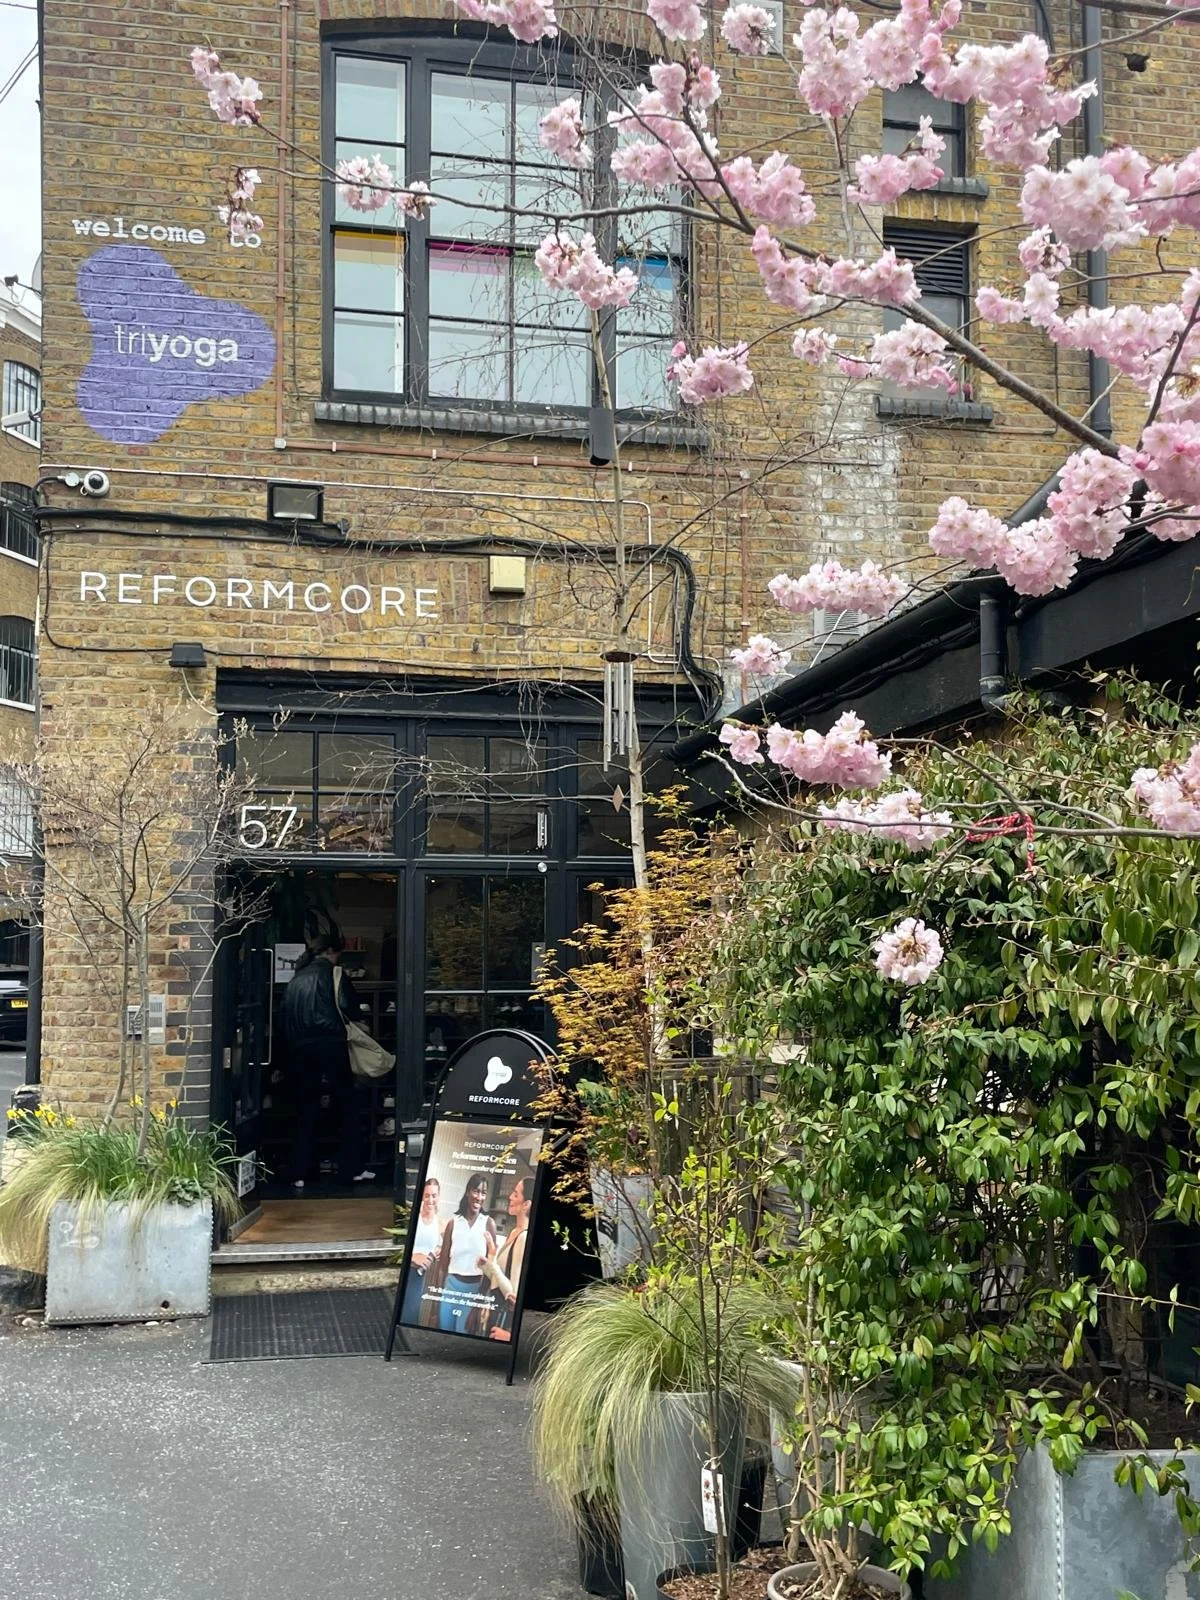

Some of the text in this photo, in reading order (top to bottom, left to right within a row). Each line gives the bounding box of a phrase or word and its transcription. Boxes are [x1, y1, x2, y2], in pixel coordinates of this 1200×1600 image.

[71, 218, 206, 245] welcome
[113, 325, 239, 367] triyoga
[79, 571, 439, 618] REFORMCORE
[240, 805, 297, 849] 57
[468, 1095, 520, 1106] REFORMCORE
